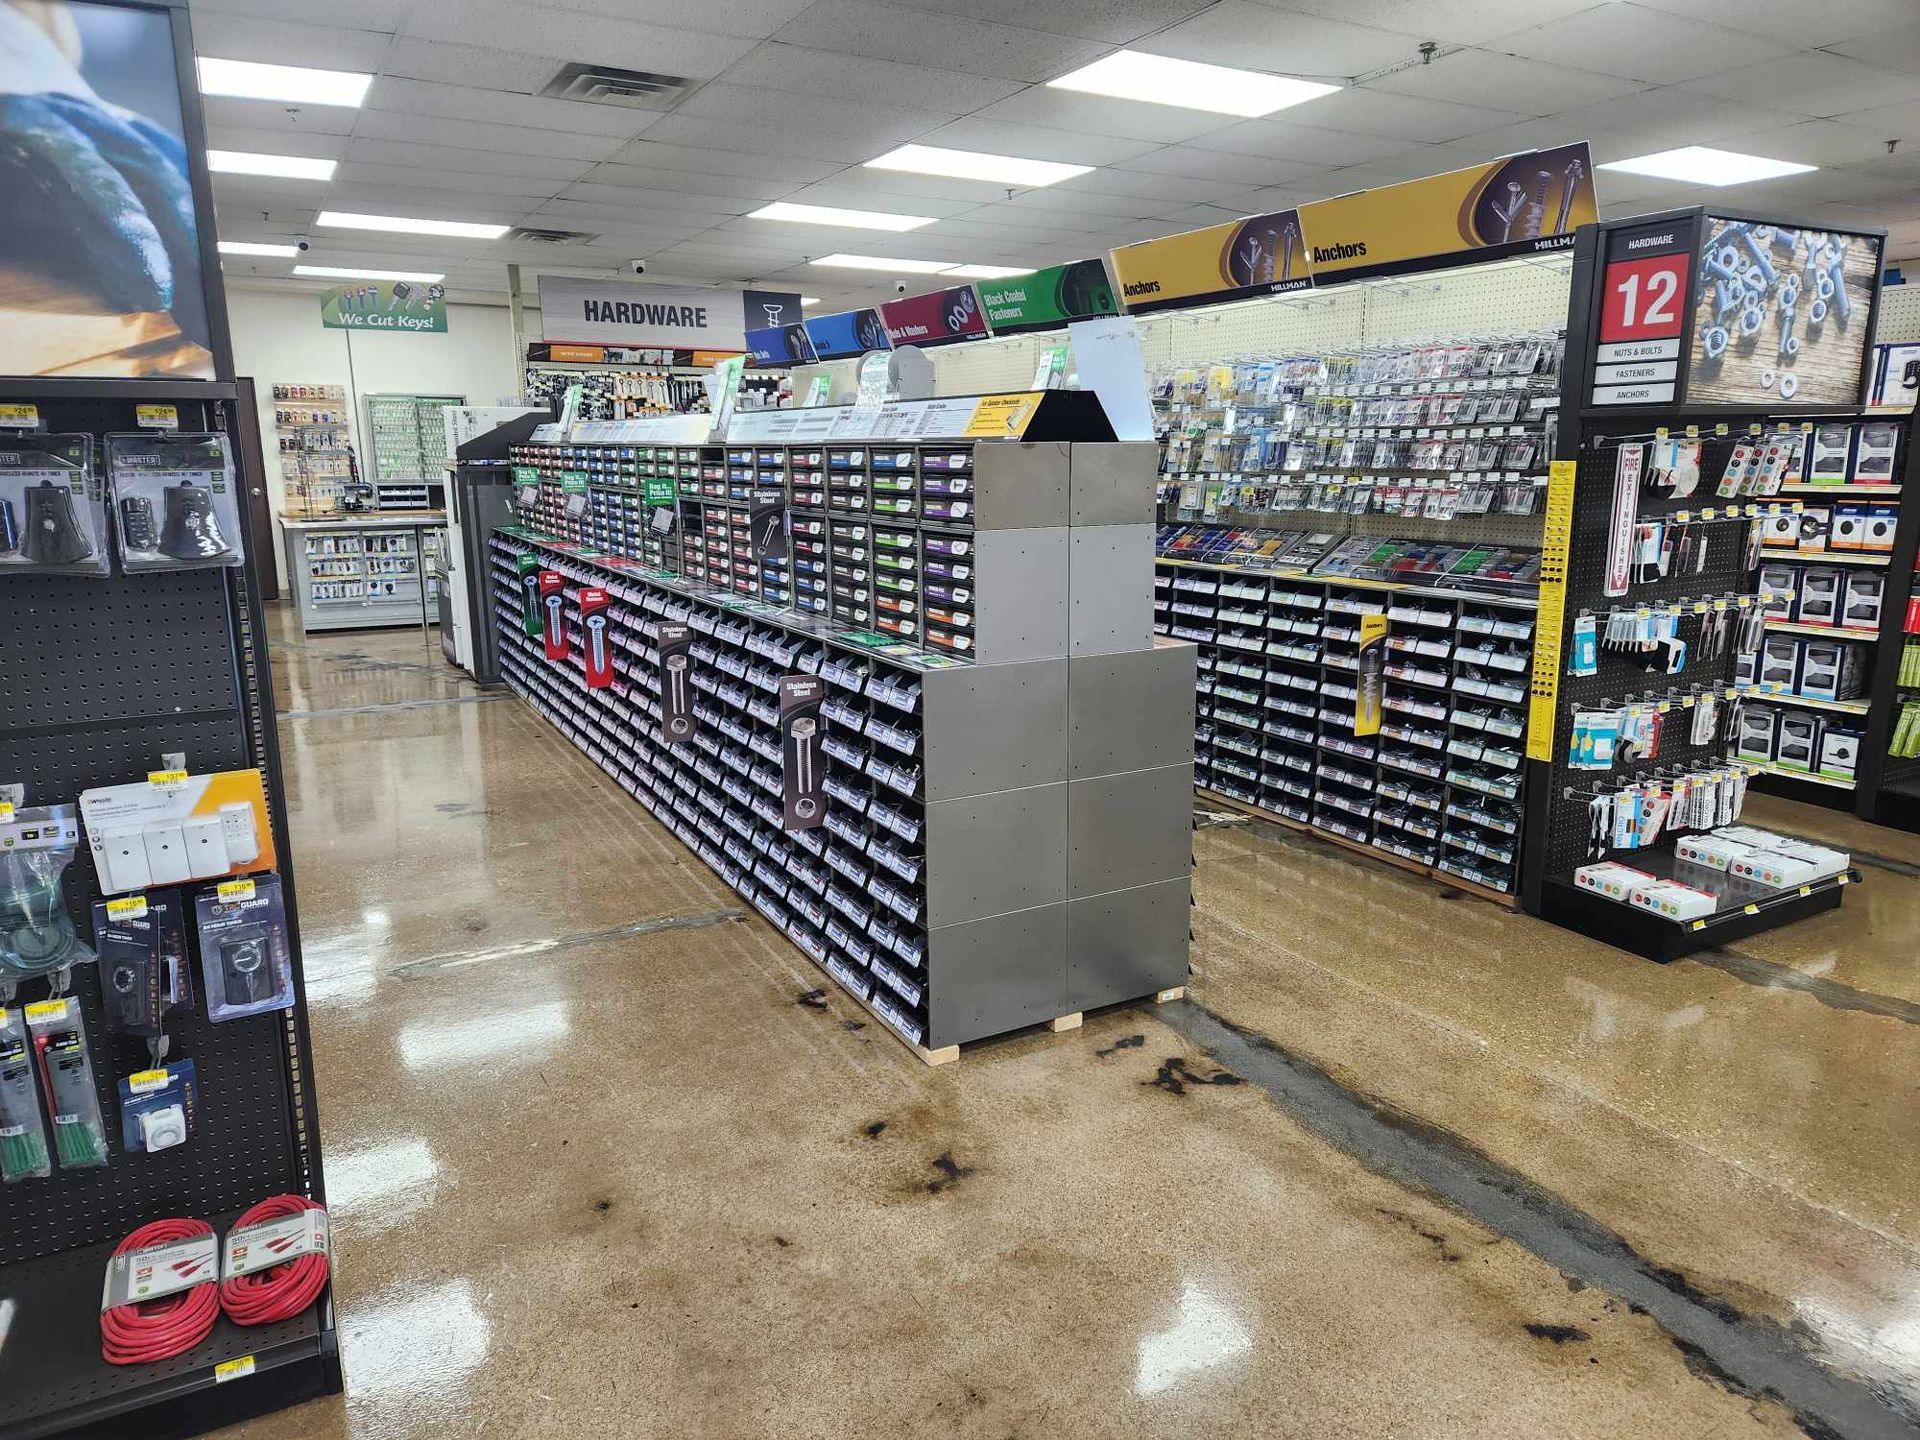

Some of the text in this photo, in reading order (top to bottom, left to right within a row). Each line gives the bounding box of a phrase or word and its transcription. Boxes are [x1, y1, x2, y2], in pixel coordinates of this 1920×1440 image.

[1535, 236, 1575, 250] HILLM
[1628, 234, 1674, 250] HARDWARE
[1313, 241, 1367, 263] Anchors
[1123, 279, 1161, 297] Anchors
[1270, 281, 1307, 292] HILLMAN
[984, 288, 1027, 305] Black Coated
[1617, 270, 1678, 327] 12
[584, 300, 708, 328] HARDWARE
[988, 307, 1023, 321] Fasteners
[339, 313, 434, 330] We Cut Keys!
[1614, 349, 1632, 357] NUTS
[1641, 346, 1663, 355] BOLTS
[1616, 368, 1655, 378] FASTENERS
[1616, 390, 1650, 399] ANCHORS
[1624, 457, 1639, 471] FIRE
[754, 490, 780, 498] Stainless
[1617, 474, 1633, 582] EXTINGUISHER
[662, 626, 688, 634] Stainless
[786, 681, 817, 689] Stainless
[793, 688, 811, 697] Steel
